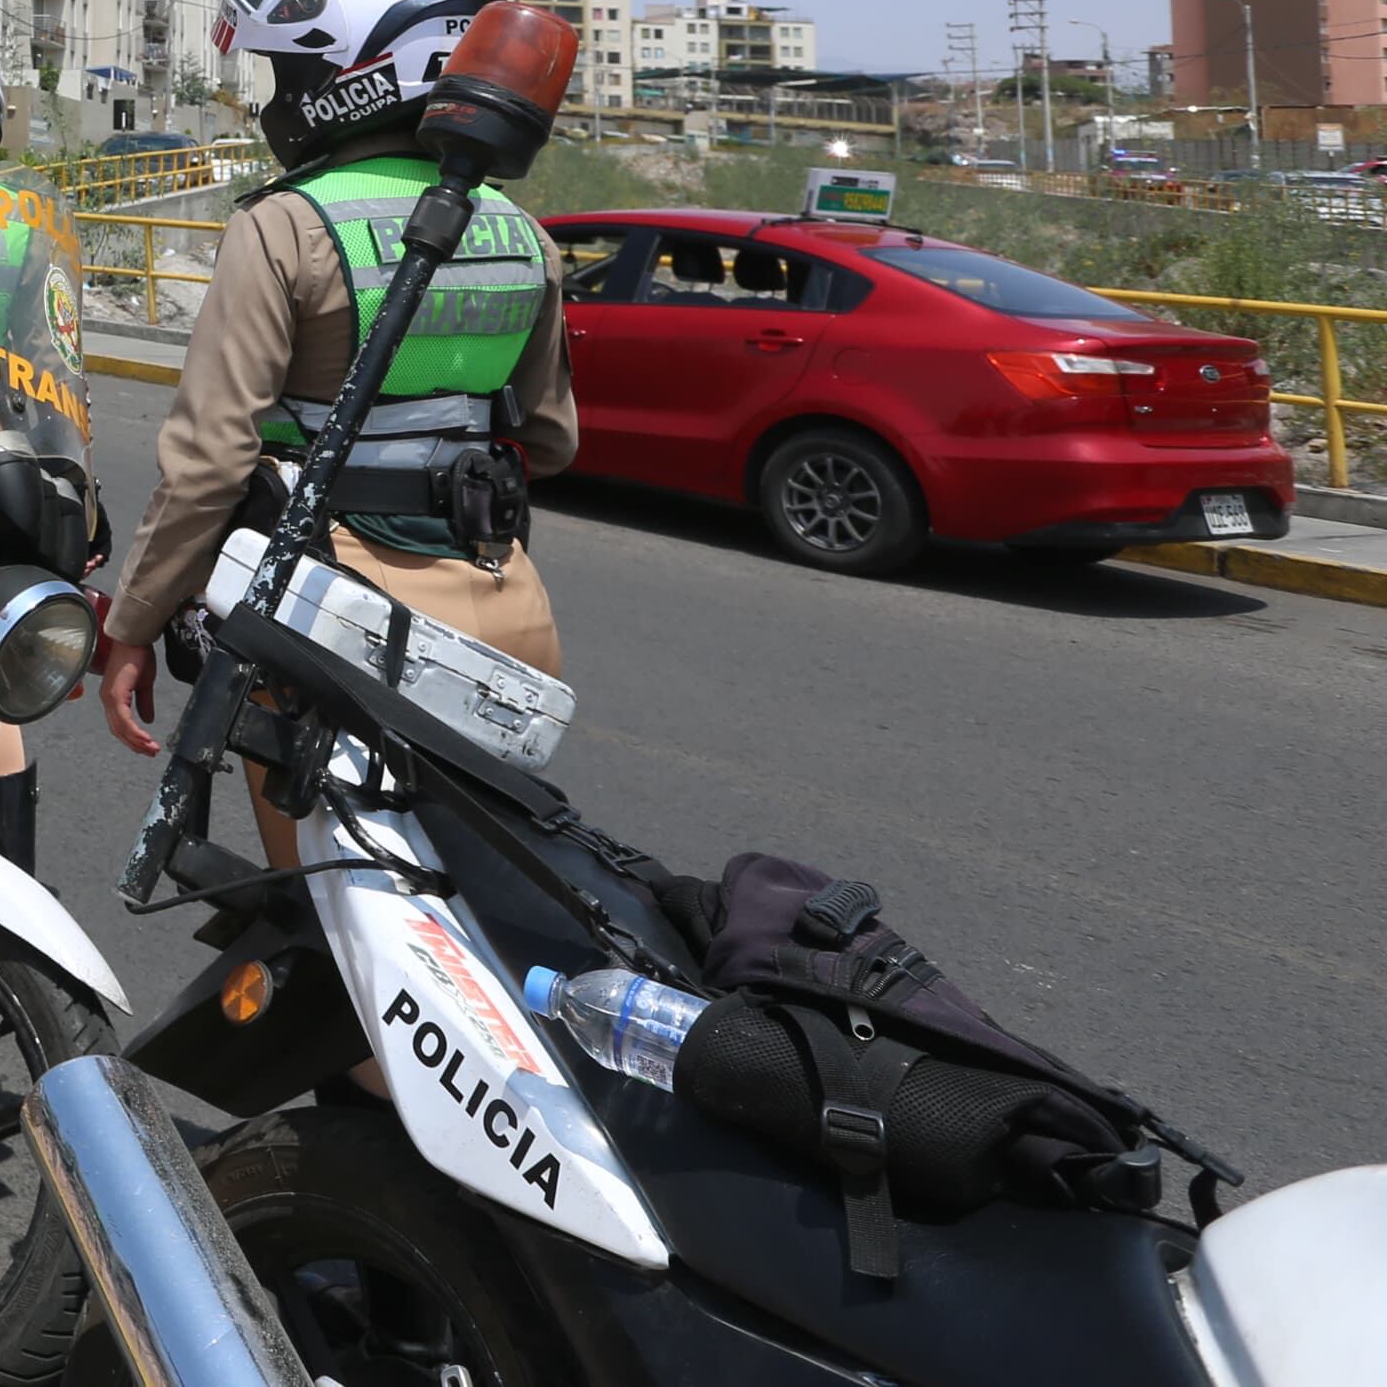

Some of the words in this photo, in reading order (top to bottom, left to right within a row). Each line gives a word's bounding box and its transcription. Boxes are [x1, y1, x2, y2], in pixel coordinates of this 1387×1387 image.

[300, 71, 396, 128] POLICIA
[373, 214, 533, 263] PCIA
[382, 987, 561, 1211] POLICIA
